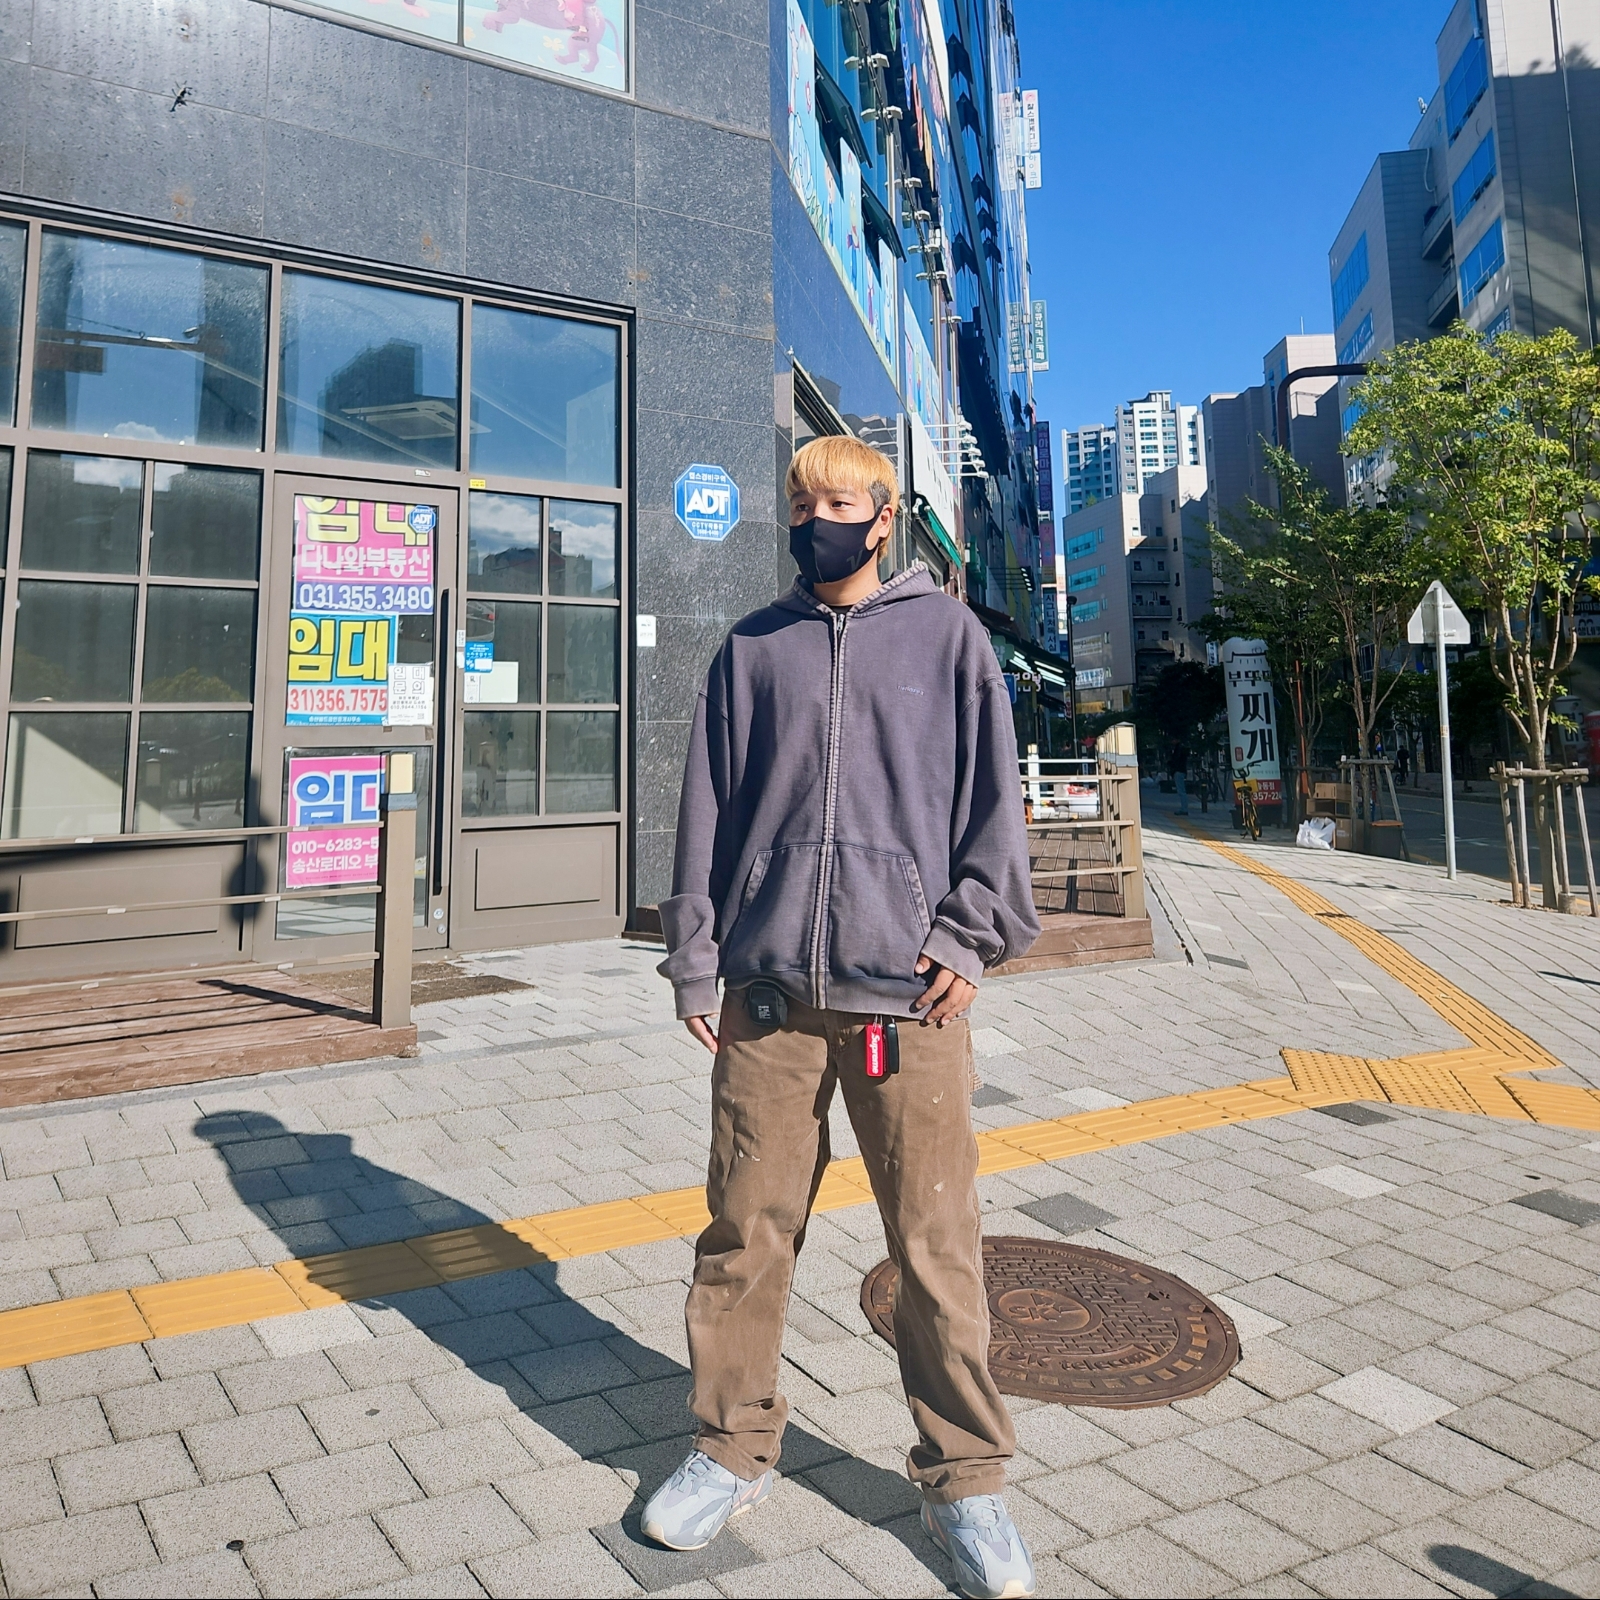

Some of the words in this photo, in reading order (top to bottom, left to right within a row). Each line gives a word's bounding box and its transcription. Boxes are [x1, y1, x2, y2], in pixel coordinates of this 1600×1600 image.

[686, 488, 729, 516] ADT
[413, 513, 432, 526] ADT
[300, 544, 430, 578] 다나와부동산
[299, 584, 433, 610] 031.355.3480
[288, 617, 390, 682] 임대
[287, 688, 388, 713] 31)356.7575
[1238, 692, 1275, 761] 찌개
[292, 855, 362, 875] 송산로데오
[869, 1032, 881, 1075] Supreme
[1059, 1351, 1154, 1371] telecom
